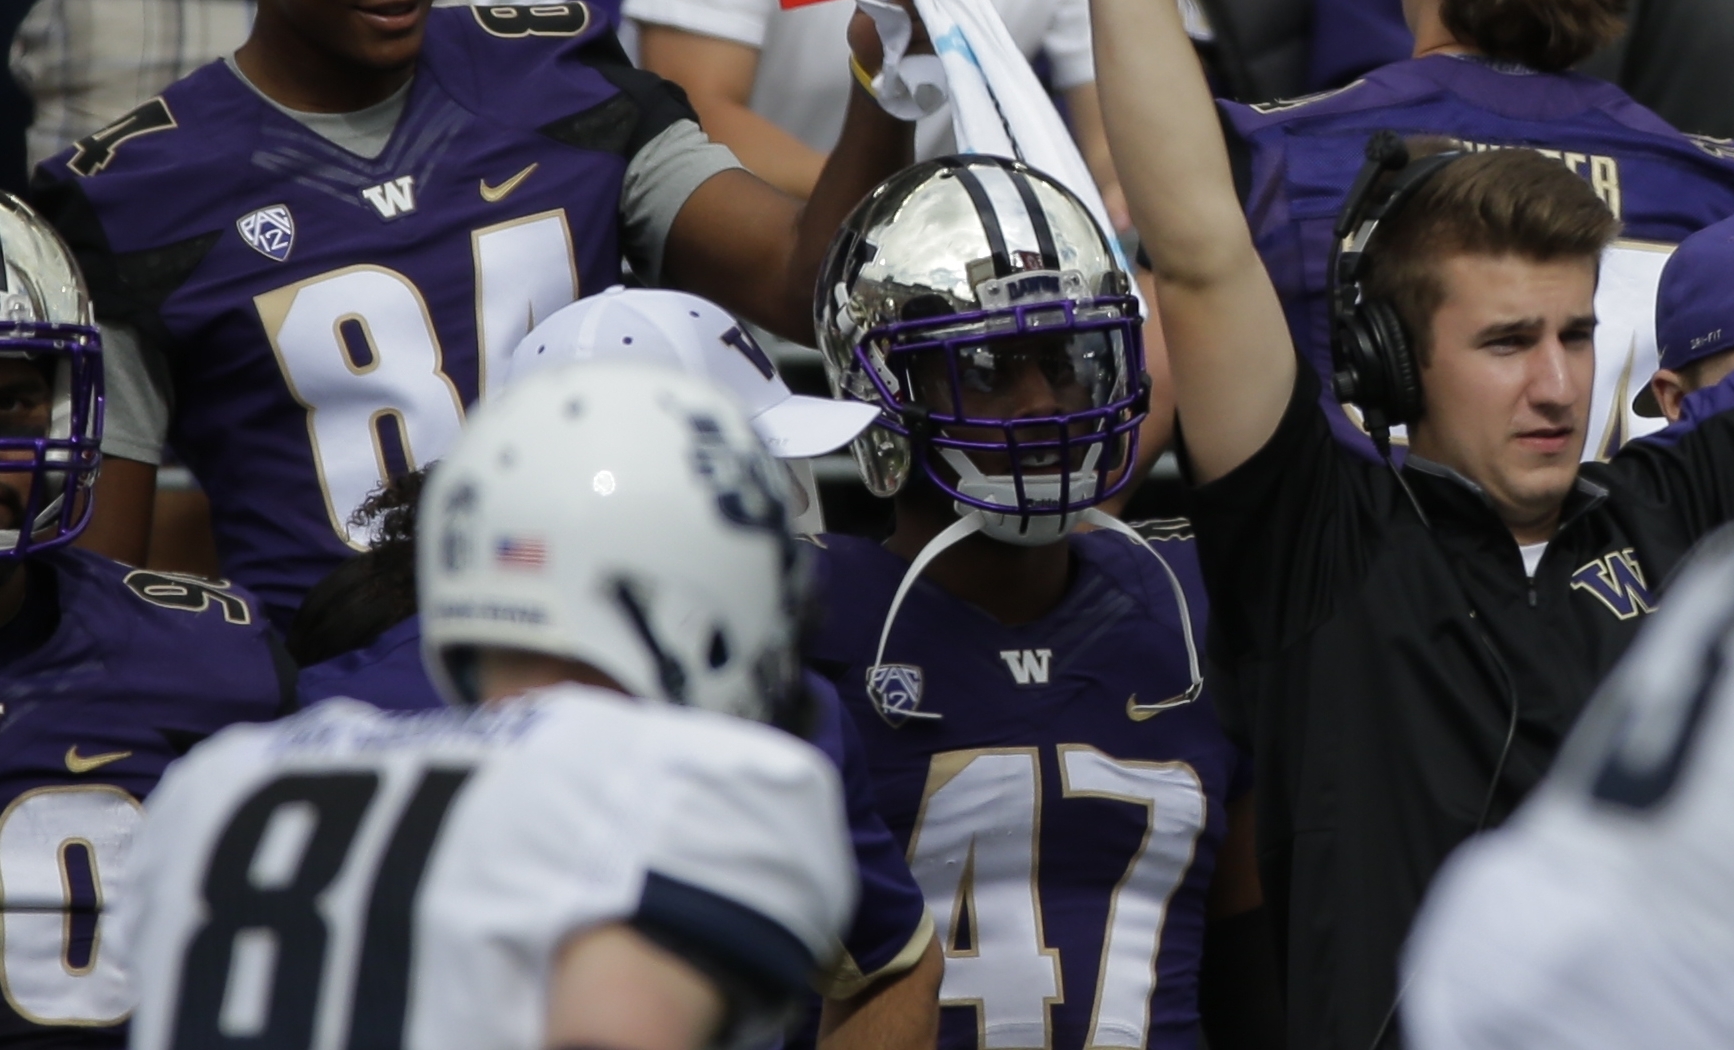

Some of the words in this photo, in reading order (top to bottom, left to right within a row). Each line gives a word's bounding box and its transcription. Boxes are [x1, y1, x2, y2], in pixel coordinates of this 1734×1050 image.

[362, 175, 415, 218] W
[239, 207, 292, 246] PAC
[259, 228, 289, 252] 12
[1570, 547, 1660, 620] W
[999, 648, 1052, 684] W
[165, 765, 478, 1050] 81
[905, 743, 1207, 1050] 47
